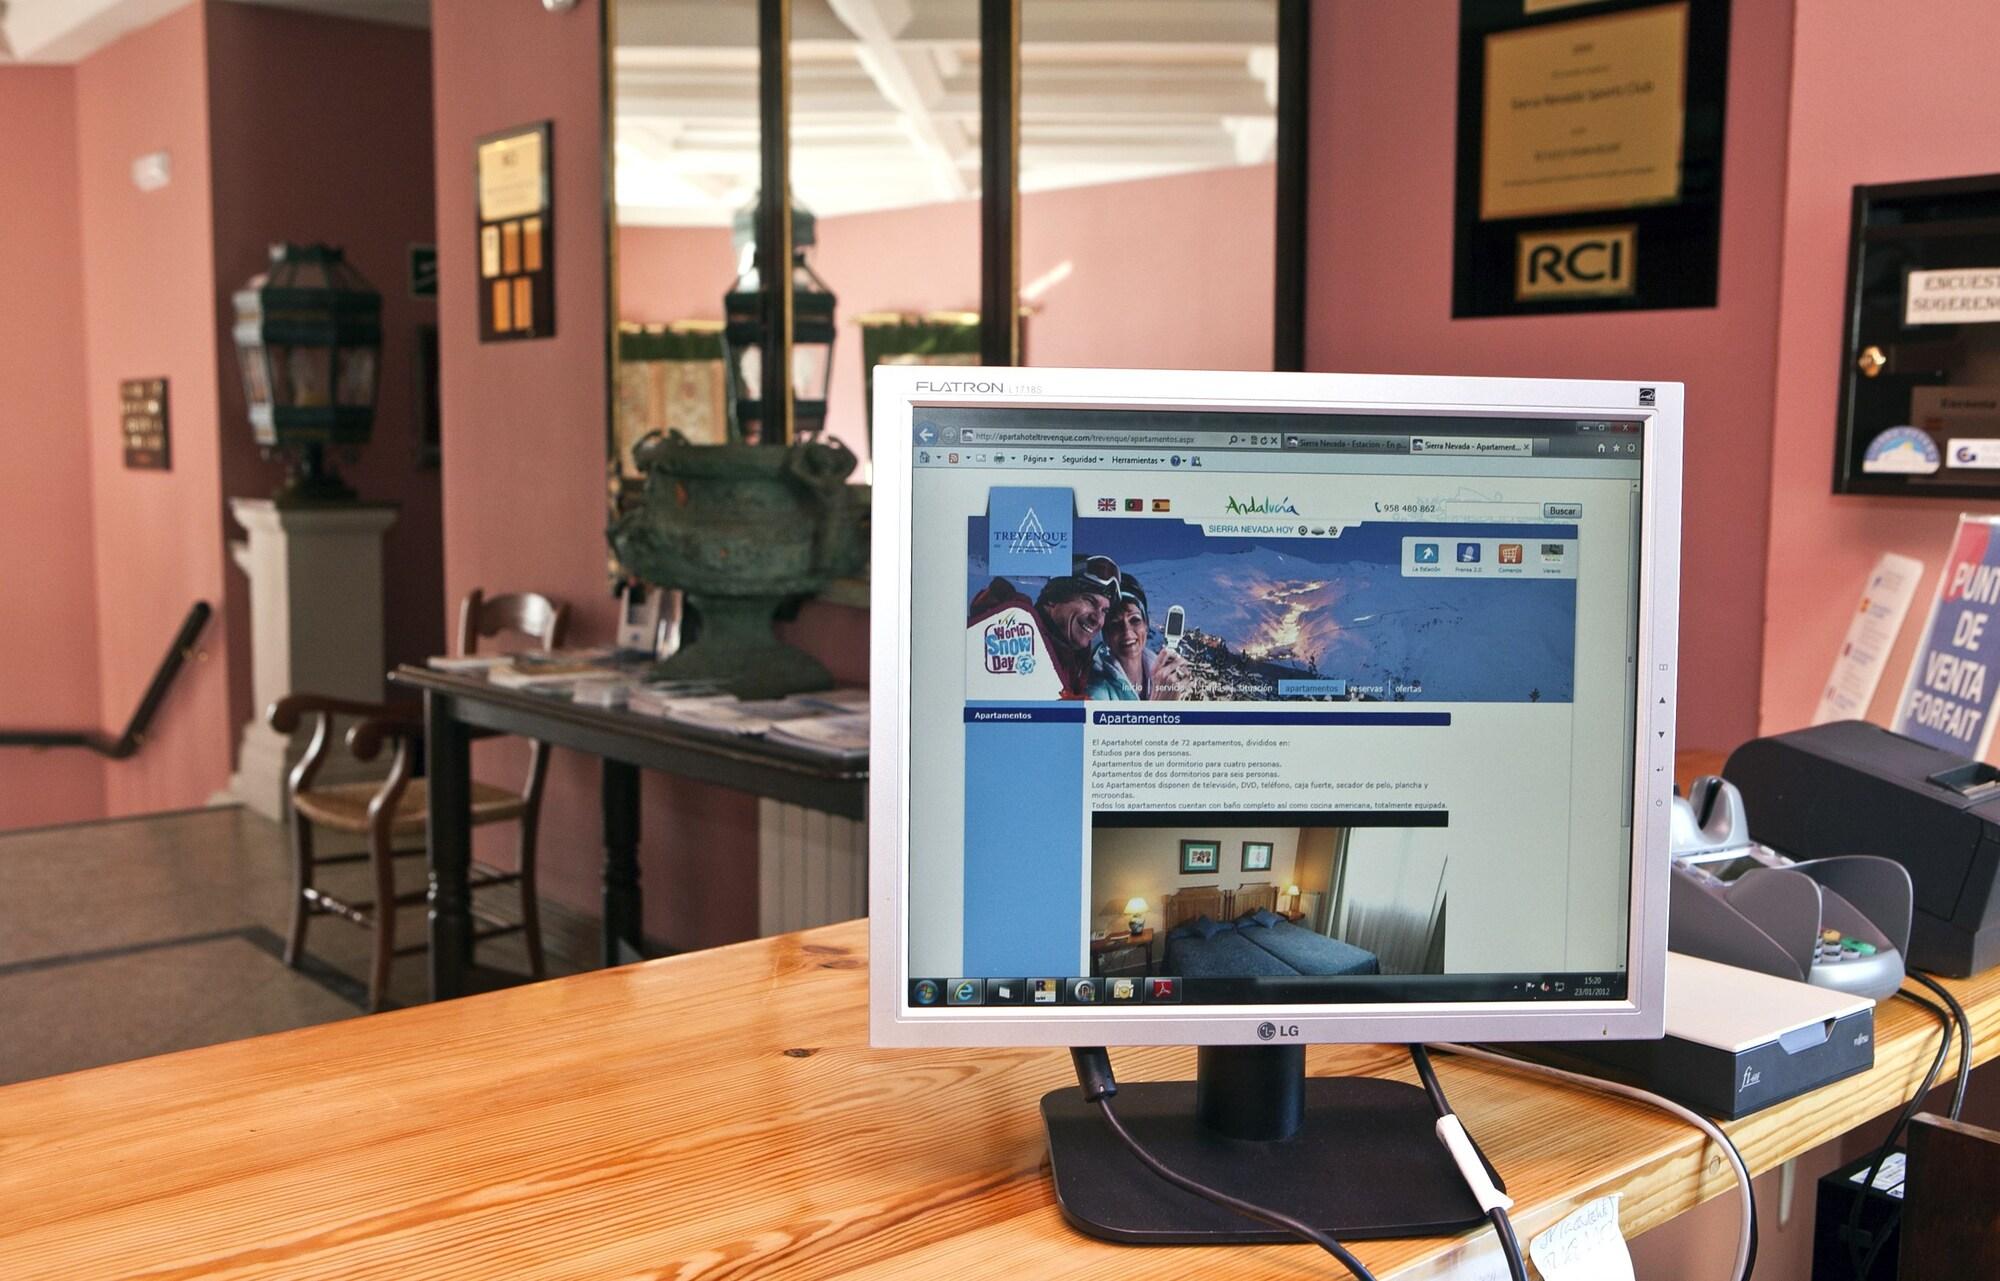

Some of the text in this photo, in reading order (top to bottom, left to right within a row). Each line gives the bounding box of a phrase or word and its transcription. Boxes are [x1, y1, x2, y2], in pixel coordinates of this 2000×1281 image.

[1528, 240, 1622, 285] RCI
[916, 381, 1004, 393] FLATRON
[1445, 441, 1470, 450] Nevada
[1023, 455, 1158, 465] Página Seguridad Herramientas
[1384, 504, 1435, 513] 958 480 862
[1550, 506, 1576, 515] Buscar
[1208, 525, 1294, 534] SIERRA NEVADA HOY
[993, 531, 1068, 546] TREVENQUE
[1952, 610, 1989, 651] DE
[986, 634, 1031, 655] Snow
[992, 655, 1015, 670] Day
[1924, 650, 1987, 704] VENTA
[1285, 685, 1338, 694] apartamentos
[1395, 685, 1422, 693] ofertas
[974, 712, 1032, 720] Apartamentos
[1099, 714, 1181, 725] Apartamentos
[1905, 689, 1982, 742] FORFAIT
[1295, 782, 1309, 790] caja
[1395, 782, 1422, 790] plancha
[1243, 802, 1275, 810] completo
[1280, 1025, 1299, 1036] LG
